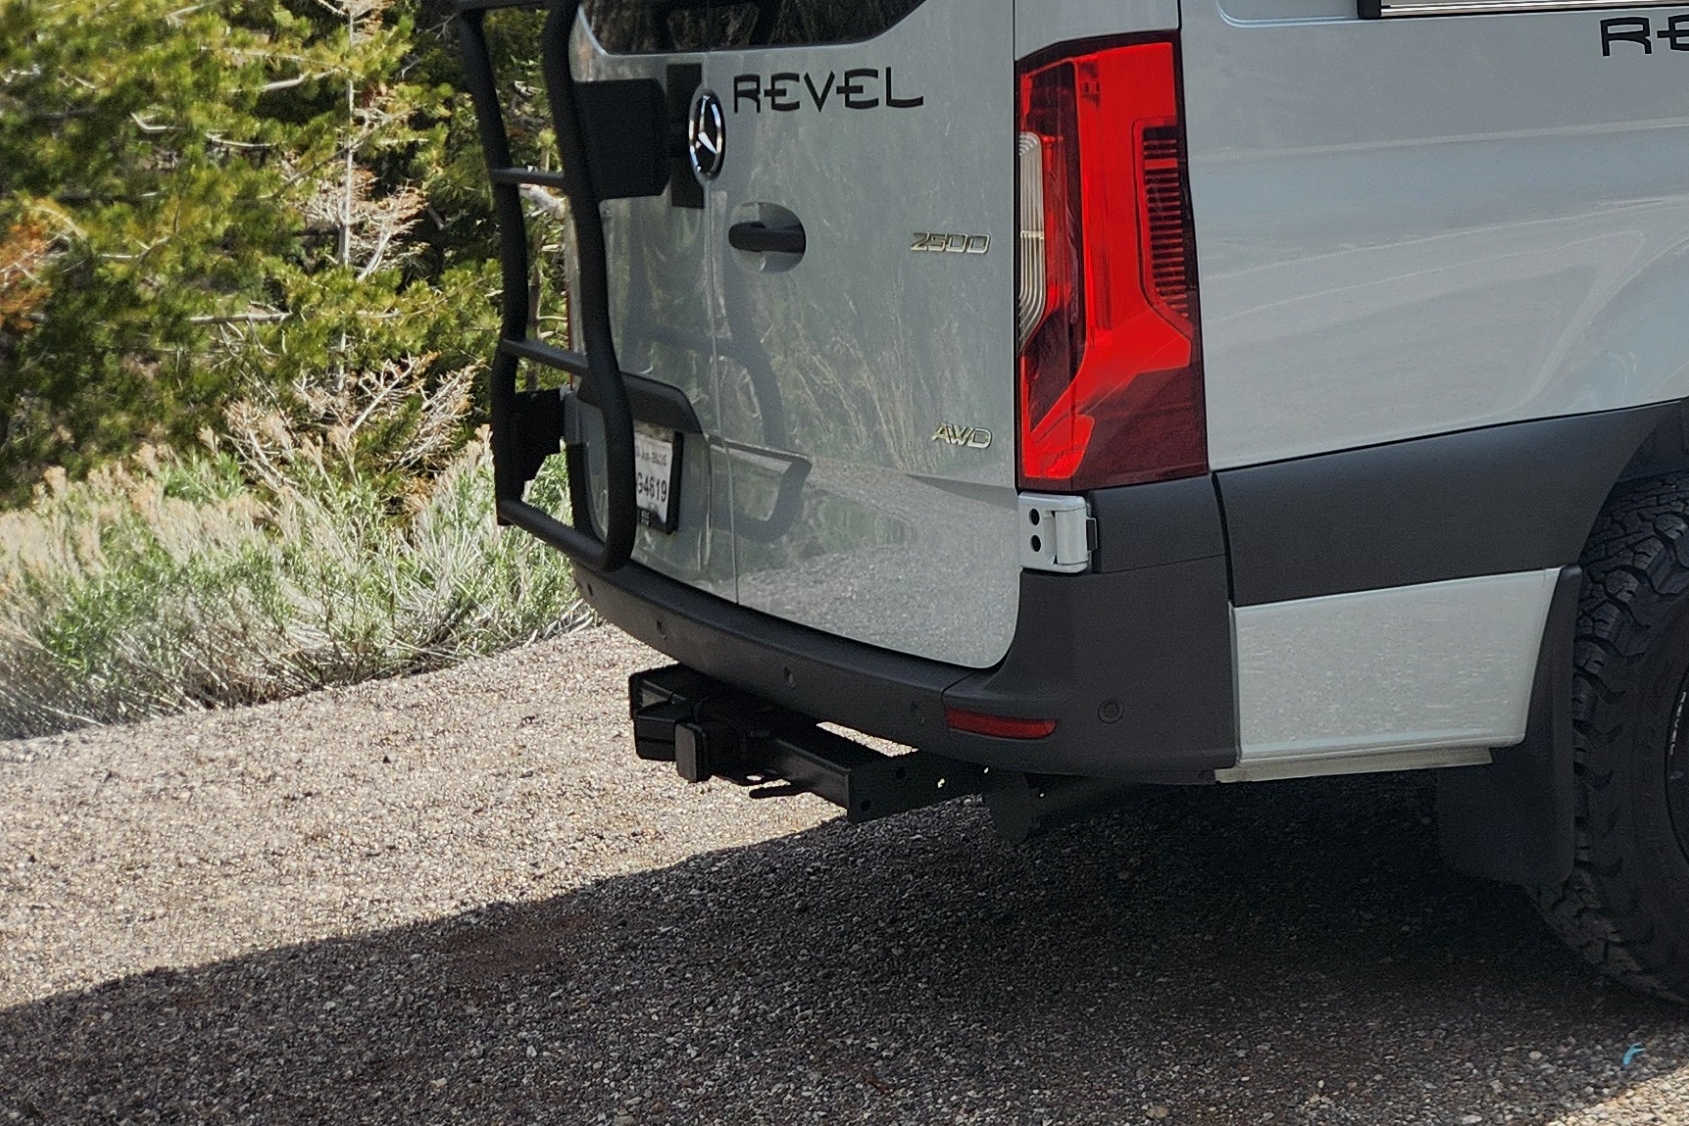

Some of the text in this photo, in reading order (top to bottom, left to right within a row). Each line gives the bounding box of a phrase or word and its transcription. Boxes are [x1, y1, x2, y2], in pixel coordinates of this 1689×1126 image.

[733, 66, 924, 114] REVEL
[910, 232, 991, 254] 2500
[931, 422, 993, 449] AWD
